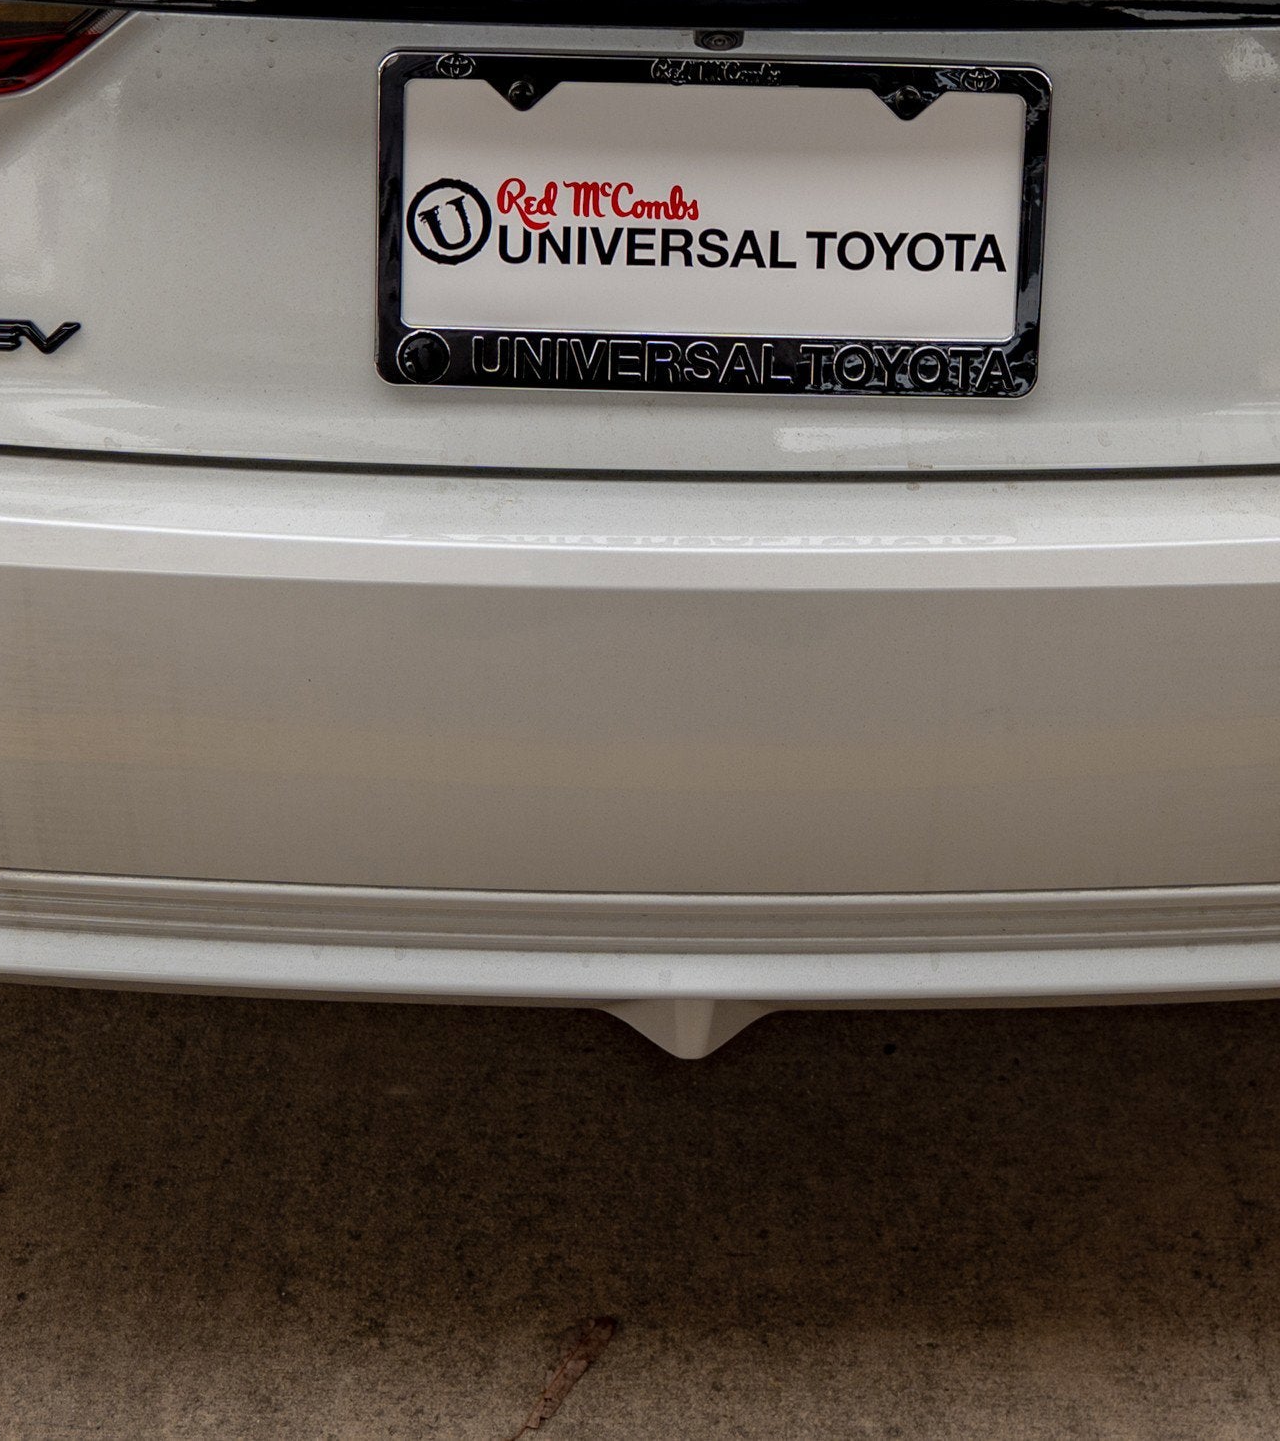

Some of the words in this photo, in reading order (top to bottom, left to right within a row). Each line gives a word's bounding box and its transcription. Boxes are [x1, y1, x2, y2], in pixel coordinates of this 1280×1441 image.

[497, 177, 556, 231] Red
[498, 225, 797, 269] UNIVERSAL
[805, 230, 1007, 273] TOYOTA
[472, 335, 792, 386] UNIVERSAL
[801, 343, 1016, 392] TOYOTA
